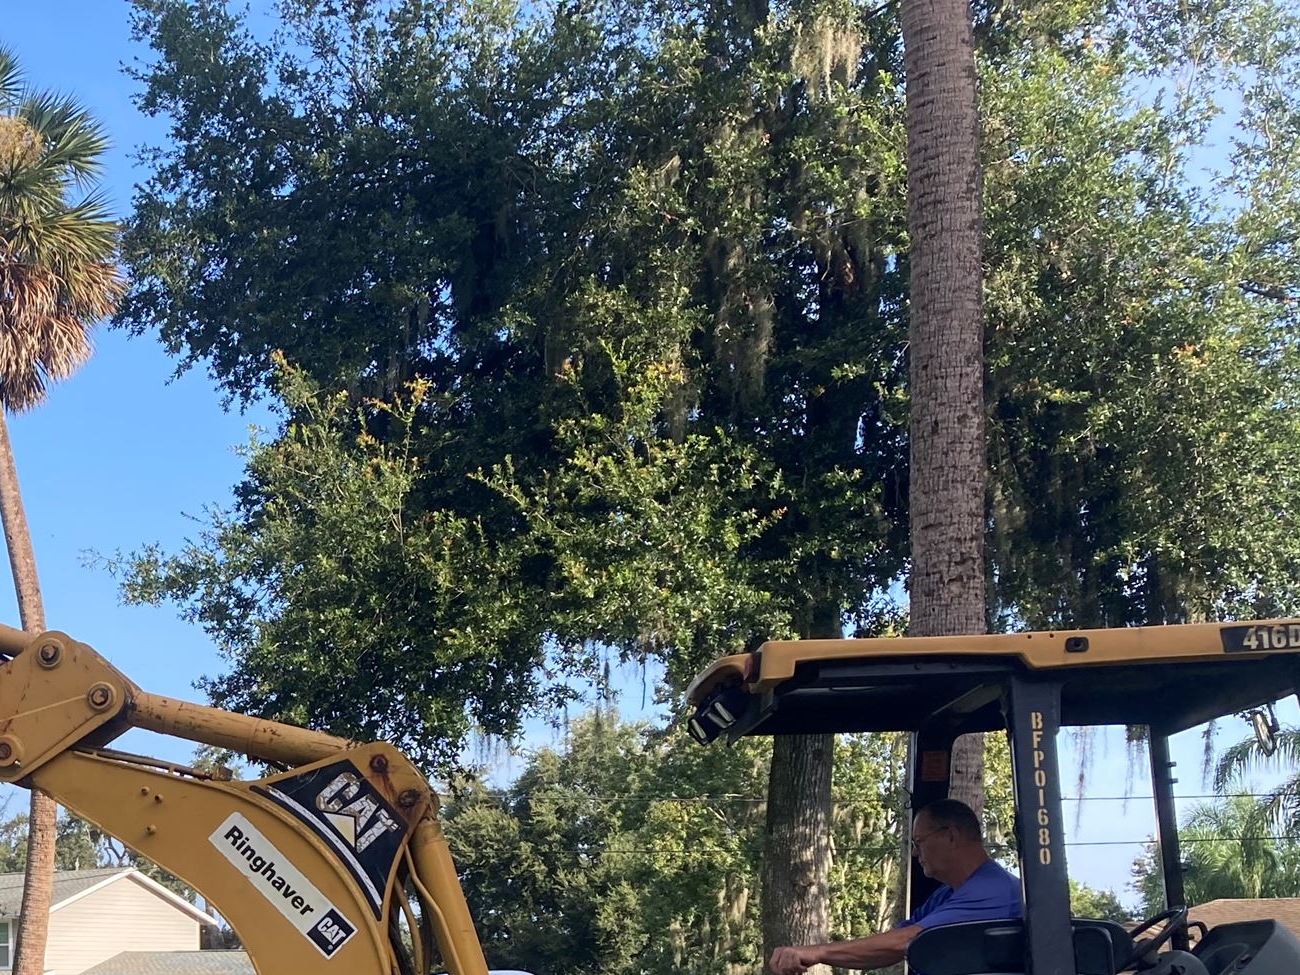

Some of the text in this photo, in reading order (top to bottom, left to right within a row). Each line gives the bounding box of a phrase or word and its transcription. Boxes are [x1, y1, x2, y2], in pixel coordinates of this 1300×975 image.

[316, 772, 399, 853] CAT
[224, 825, 347, 945] Ringhaver CAT
